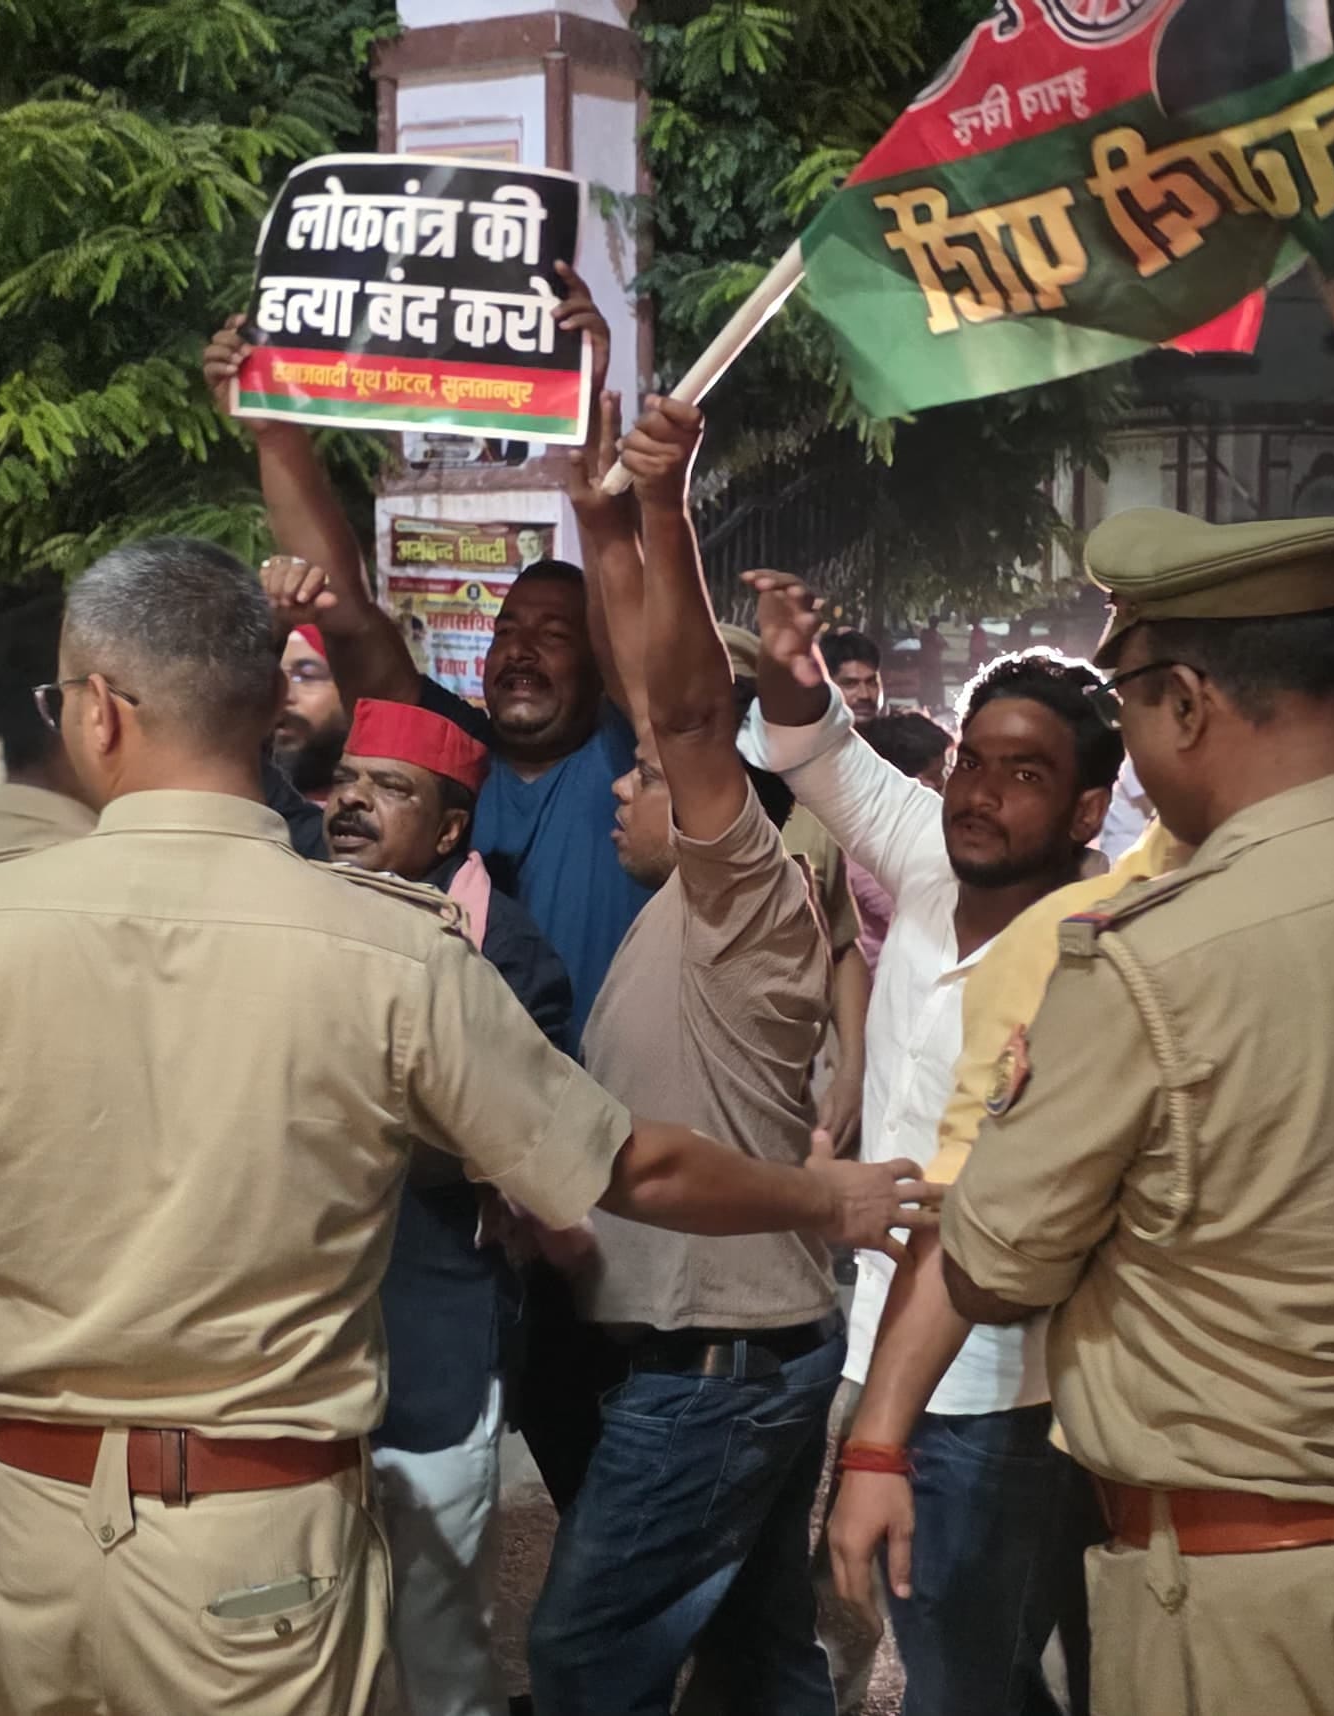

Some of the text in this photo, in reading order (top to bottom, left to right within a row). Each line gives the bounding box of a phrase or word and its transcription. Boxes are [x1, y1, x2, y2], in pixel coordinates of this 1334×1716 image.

[286, 176, 548, 265] लोकतंत्र की
[256, 268, 563, 354] हत्या बंद करो
[351, 368, 381, 395] यूथ
[440, 375, 534, 408] सुलतानपुर
